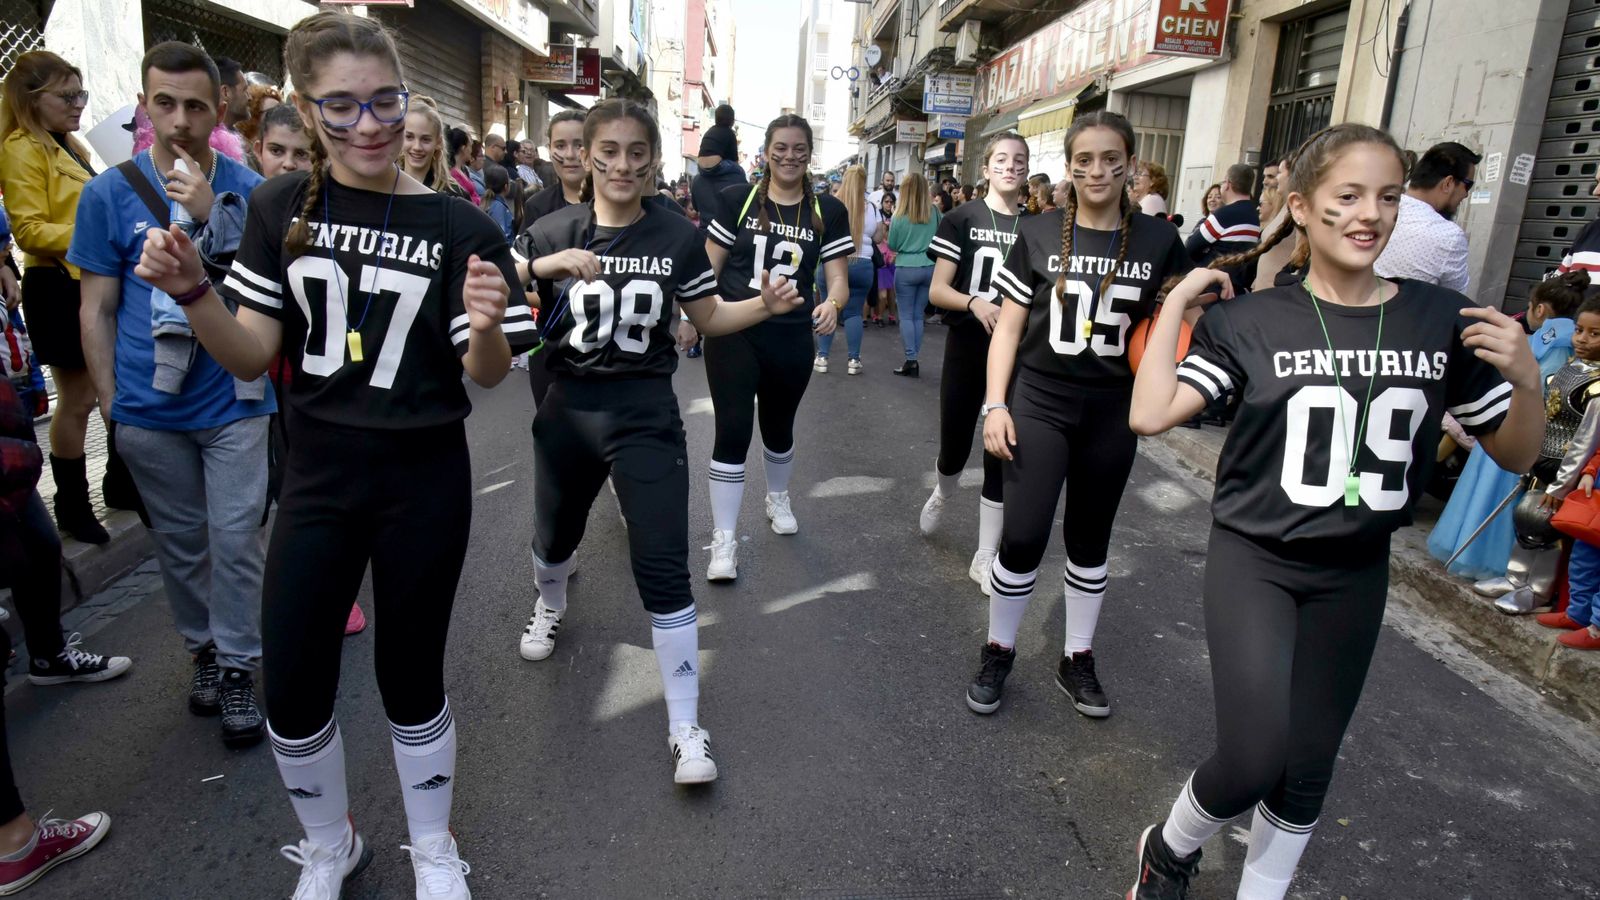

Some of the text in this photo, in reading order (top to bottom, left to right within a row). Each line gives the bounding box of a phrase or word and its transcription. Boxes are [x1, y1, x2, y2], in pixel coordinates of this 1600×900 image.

[986, 0, 1134, 110] BAZAR CHEN
[1161, 15, 1220, 37] CHEN
[291, 216, 443, 271] ENTURIAS
[745, 216, 814, 242] CETURIAS
[748, 234, 804, 290] 12
[287, 256, 432, 390] 07
[568, 279, 664, 354] 08
[1048, 279, 1142, 357] 05
[1273, 350, 1448, 381] CENTURIAS
[1280, 385, 1429, 512] 09
